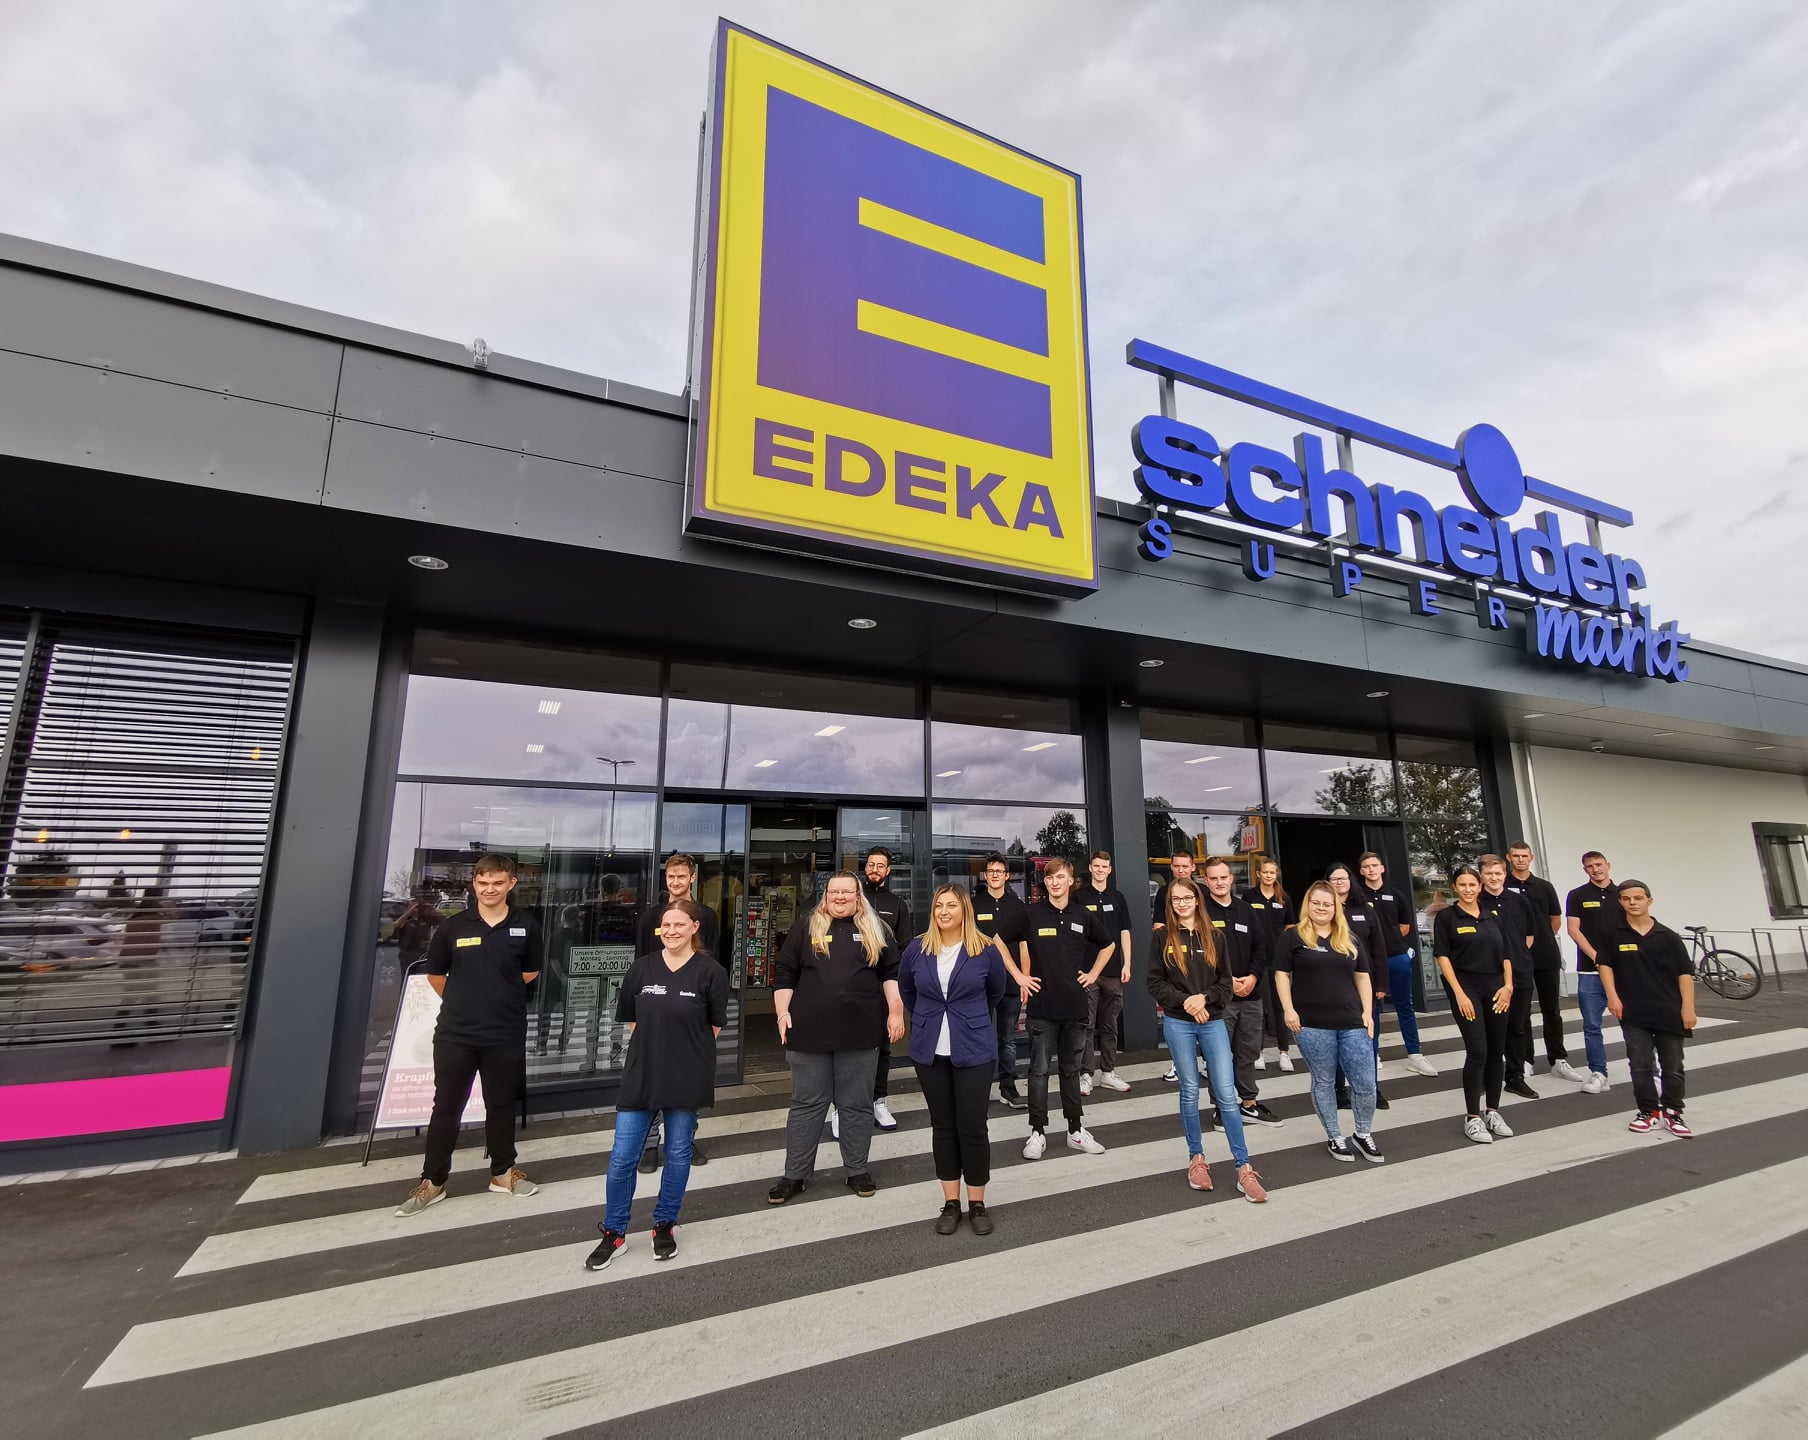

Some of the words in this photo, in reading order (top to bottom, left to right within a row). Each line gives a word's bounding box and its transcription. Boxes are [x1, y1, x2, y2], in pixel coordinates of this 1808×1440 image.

[752, 417, 1065, 539] EDEKA
[1131, 414, 1647, 614] schneider
[1137, 518, 1509, 630] SUPER
[1526, 602, 1691, 683] markt
[574, 962, 591, 971] 7:00
[598, 961, 619, 970] 20:00
[620, 960, 632, 969] Uh
[393, 1071, 435, 1084] Krapfe
